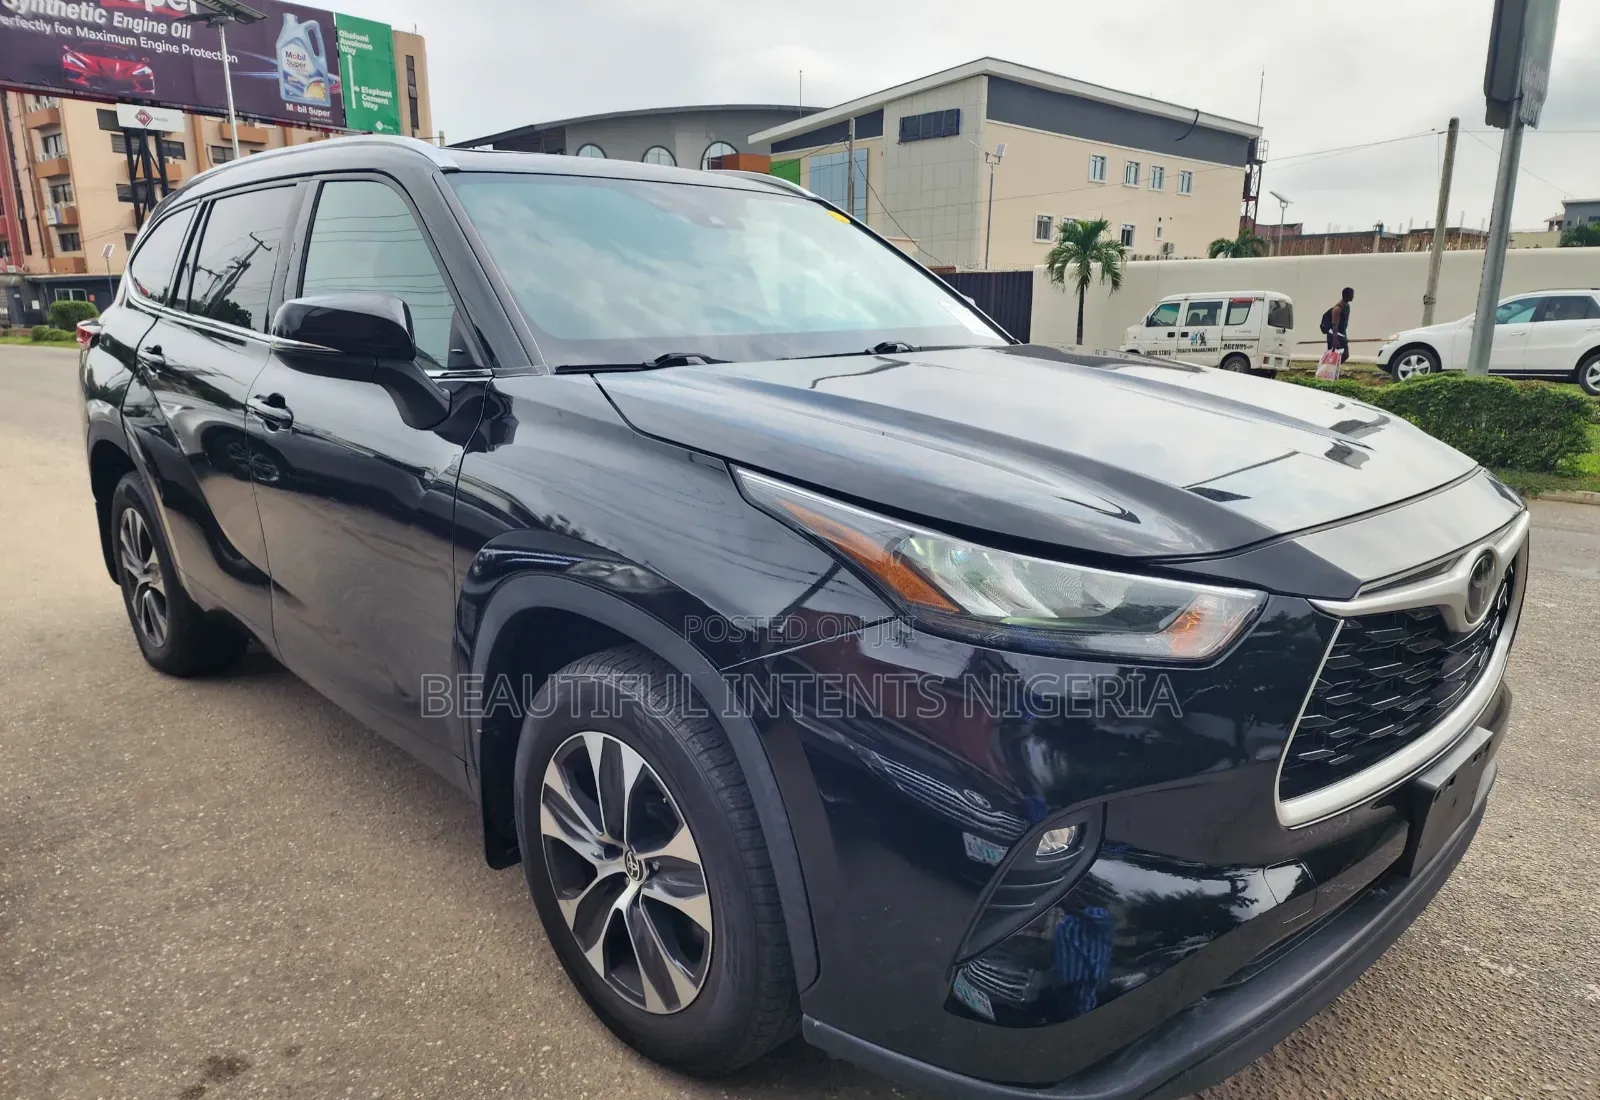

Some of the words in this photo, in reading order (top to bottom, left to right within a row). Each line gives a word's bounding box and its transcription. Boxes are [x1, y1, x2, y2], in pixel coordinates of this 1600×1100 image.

[113, 12, 167, 33] Engine
[171, 22, 191, 39] Oil
[0, 15, 52, 35] erfectly
[54, 21, 73, 35] for
[76, 25, 138, 46] Maximum
[140, 37, 180, 53] Engine
[182, 44, 239, 63] Protecton
[285, 51, 306, 61] Mobil
[340, 44, 356, 56] Way
[286, 59, 306, 68] Super
[361, 86, 393, 98] Elephant
[361, 94, 389, 105] Cement
[285, 103, 307, 114] Mobil
[308, 106, 331, 117] Super
[362, 101, 379, 112] Way
